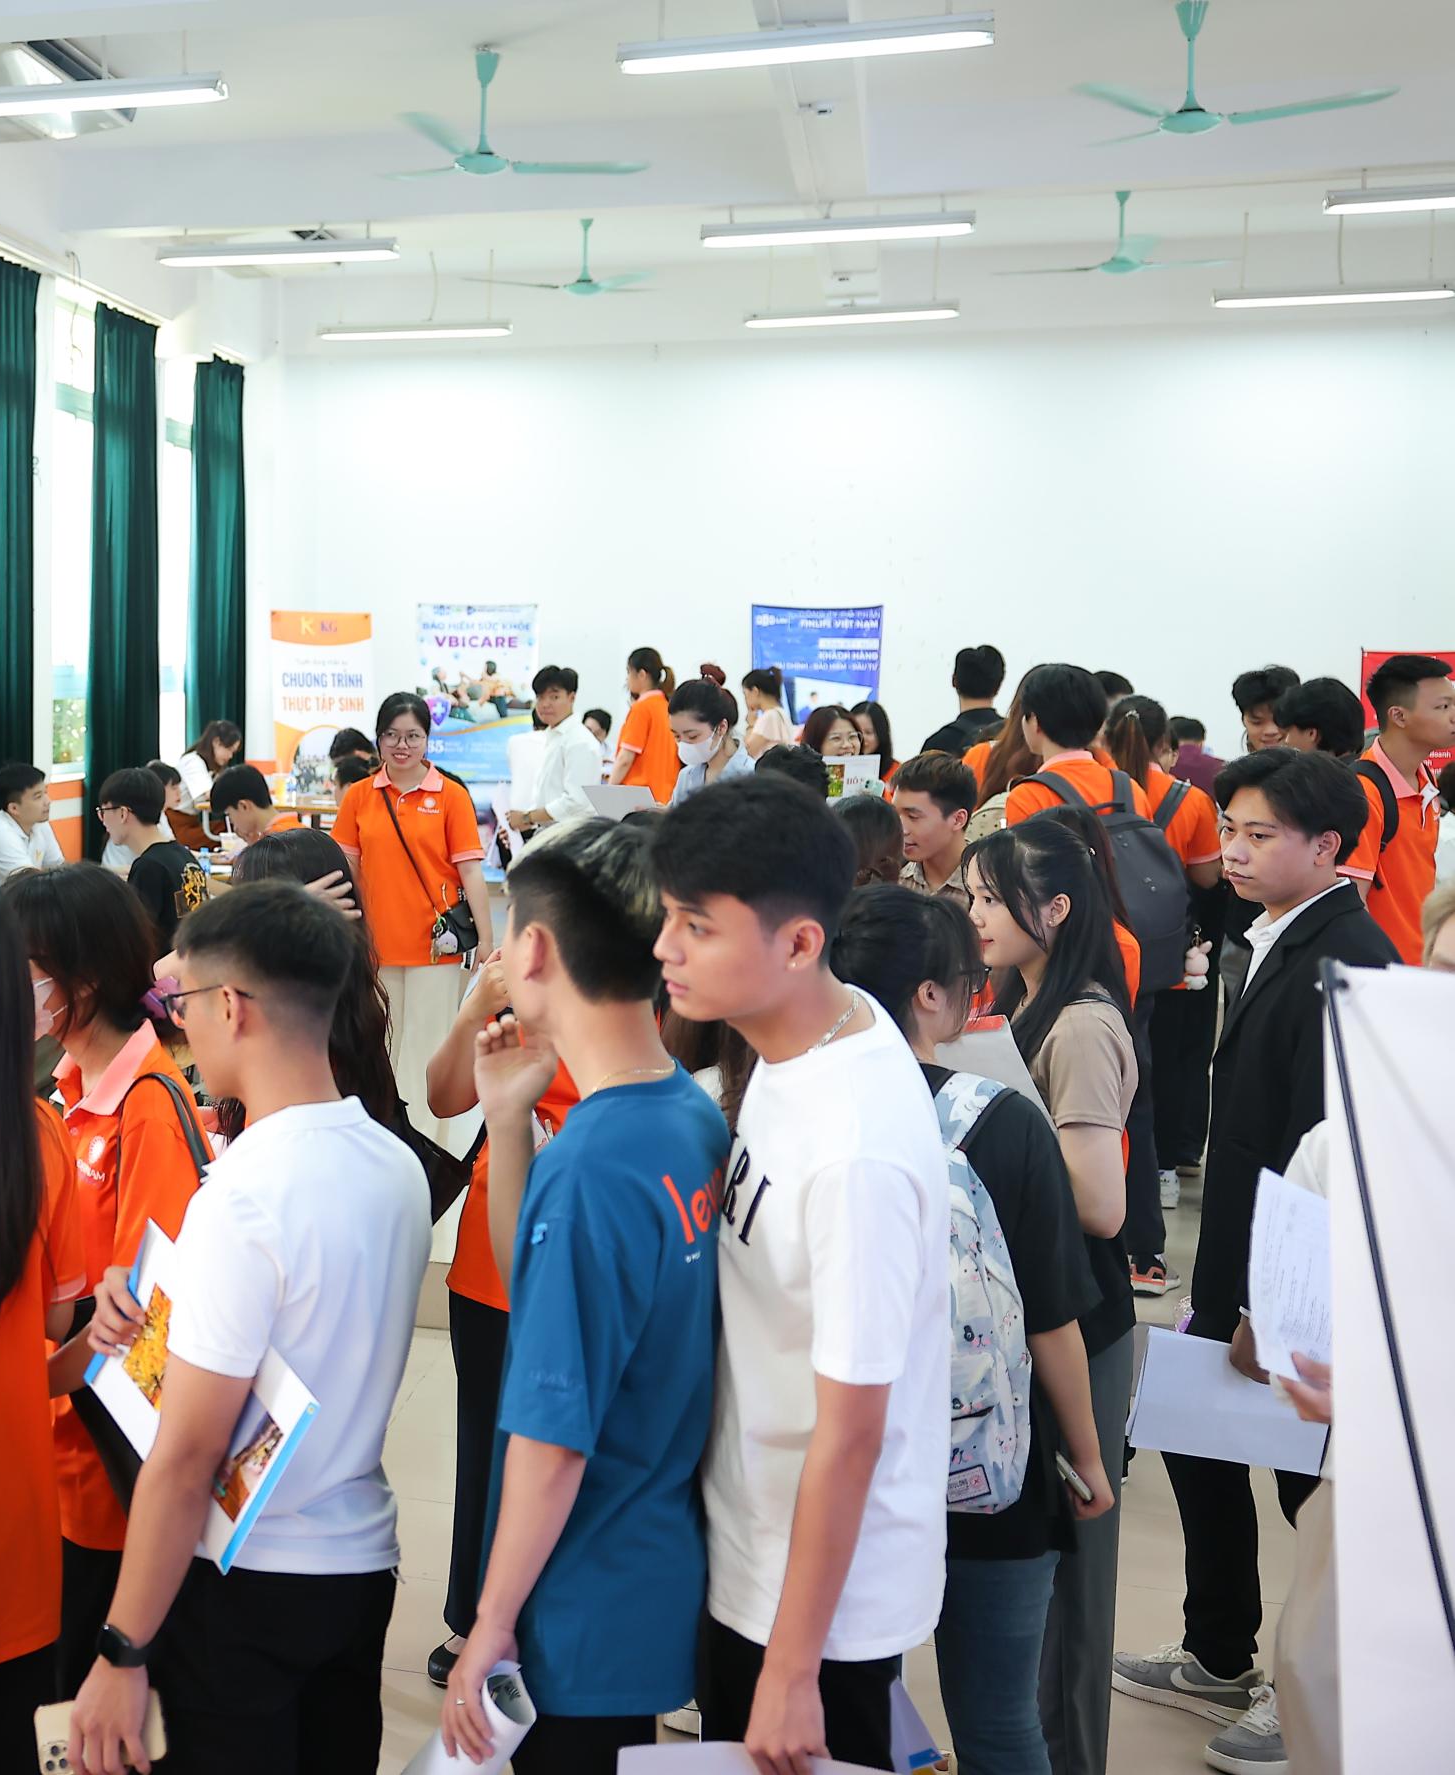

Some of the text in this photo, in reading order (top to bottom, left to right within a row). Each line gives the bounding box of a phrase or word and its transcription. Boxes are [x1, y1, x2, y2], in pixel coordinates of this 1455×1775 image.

[435, 636, 518, 648] VBICARE
[339, 696, 365, 712] SINH
[723, 1132, 772, 1246] RI
